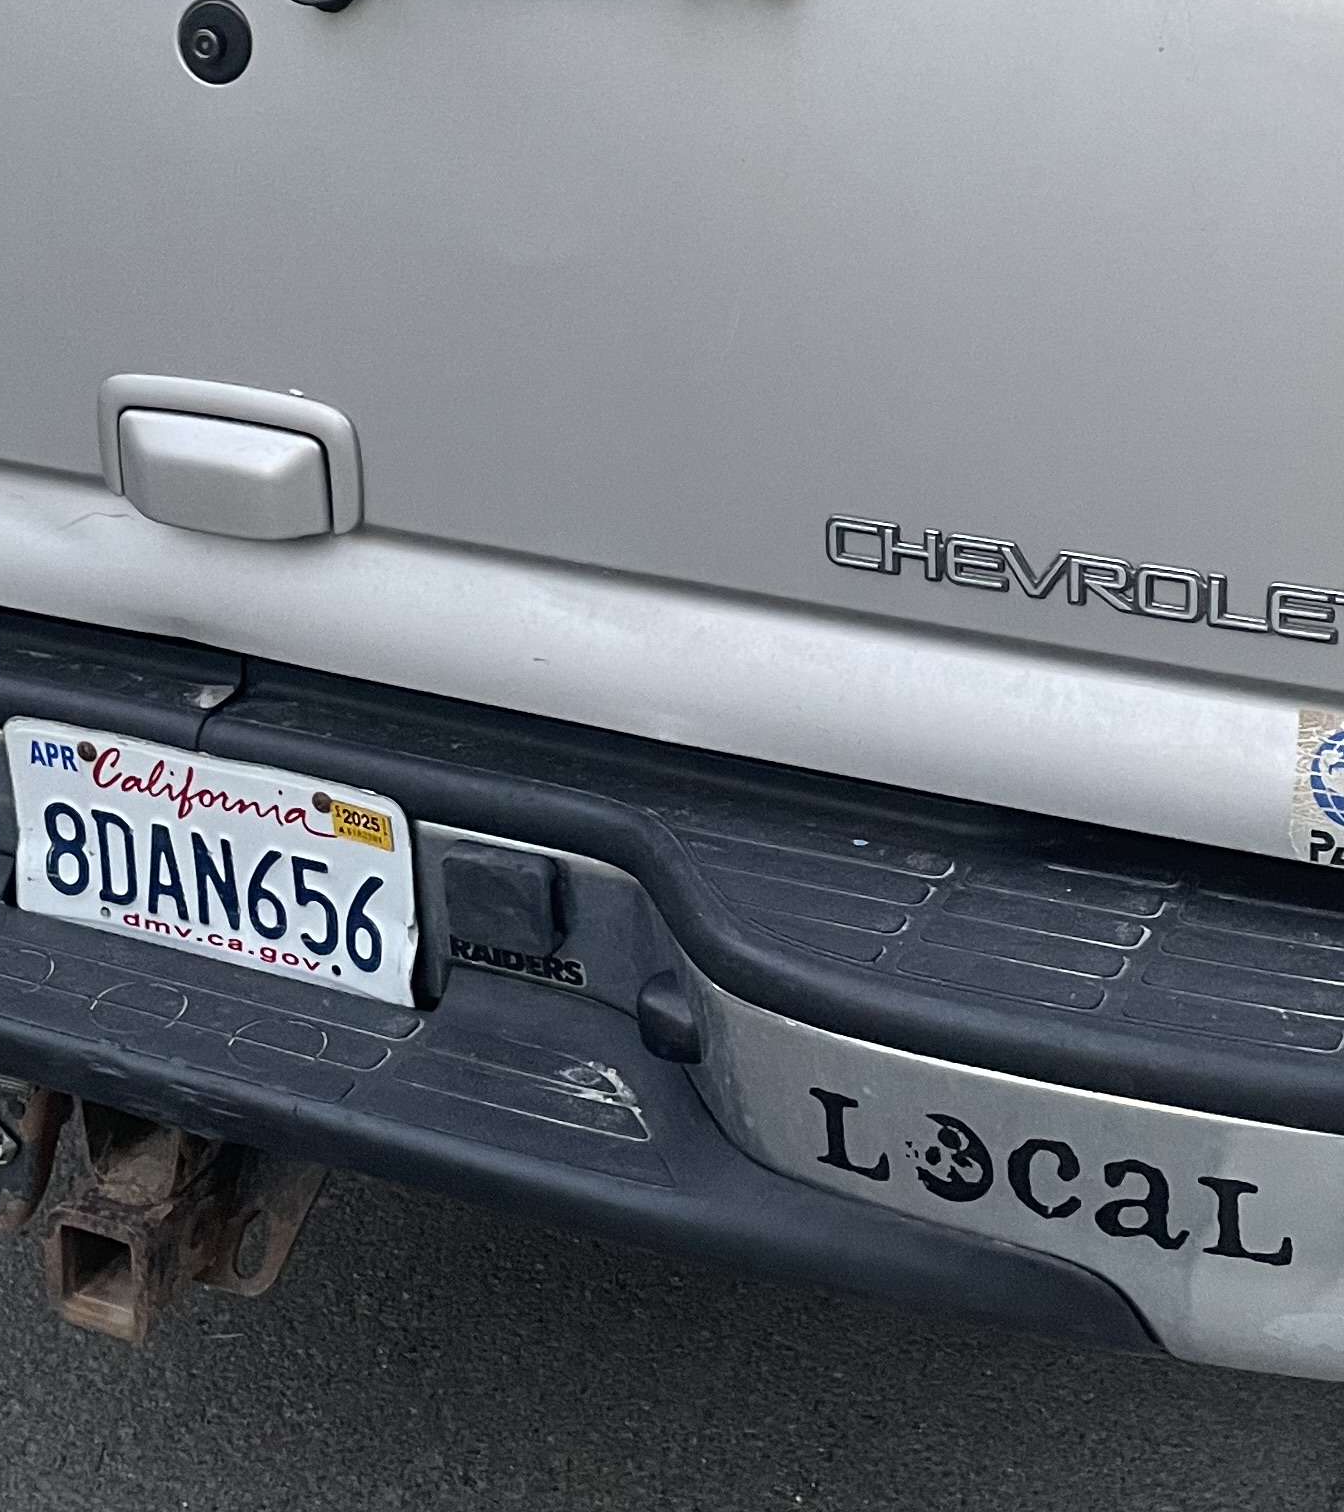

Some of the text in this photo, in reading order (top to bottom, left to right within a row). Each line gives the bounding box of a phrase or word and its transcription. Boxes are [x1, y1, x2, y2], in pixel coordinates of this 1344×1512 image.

[30, 740, 338, 838] APR California
[342, 808, 380, 833] 2025
[44, 801, 385, 973] 8DAN656
[123, 911, 322, 973] dmv.ca.gov
[449, 933, 584, 987] RAIDERS
